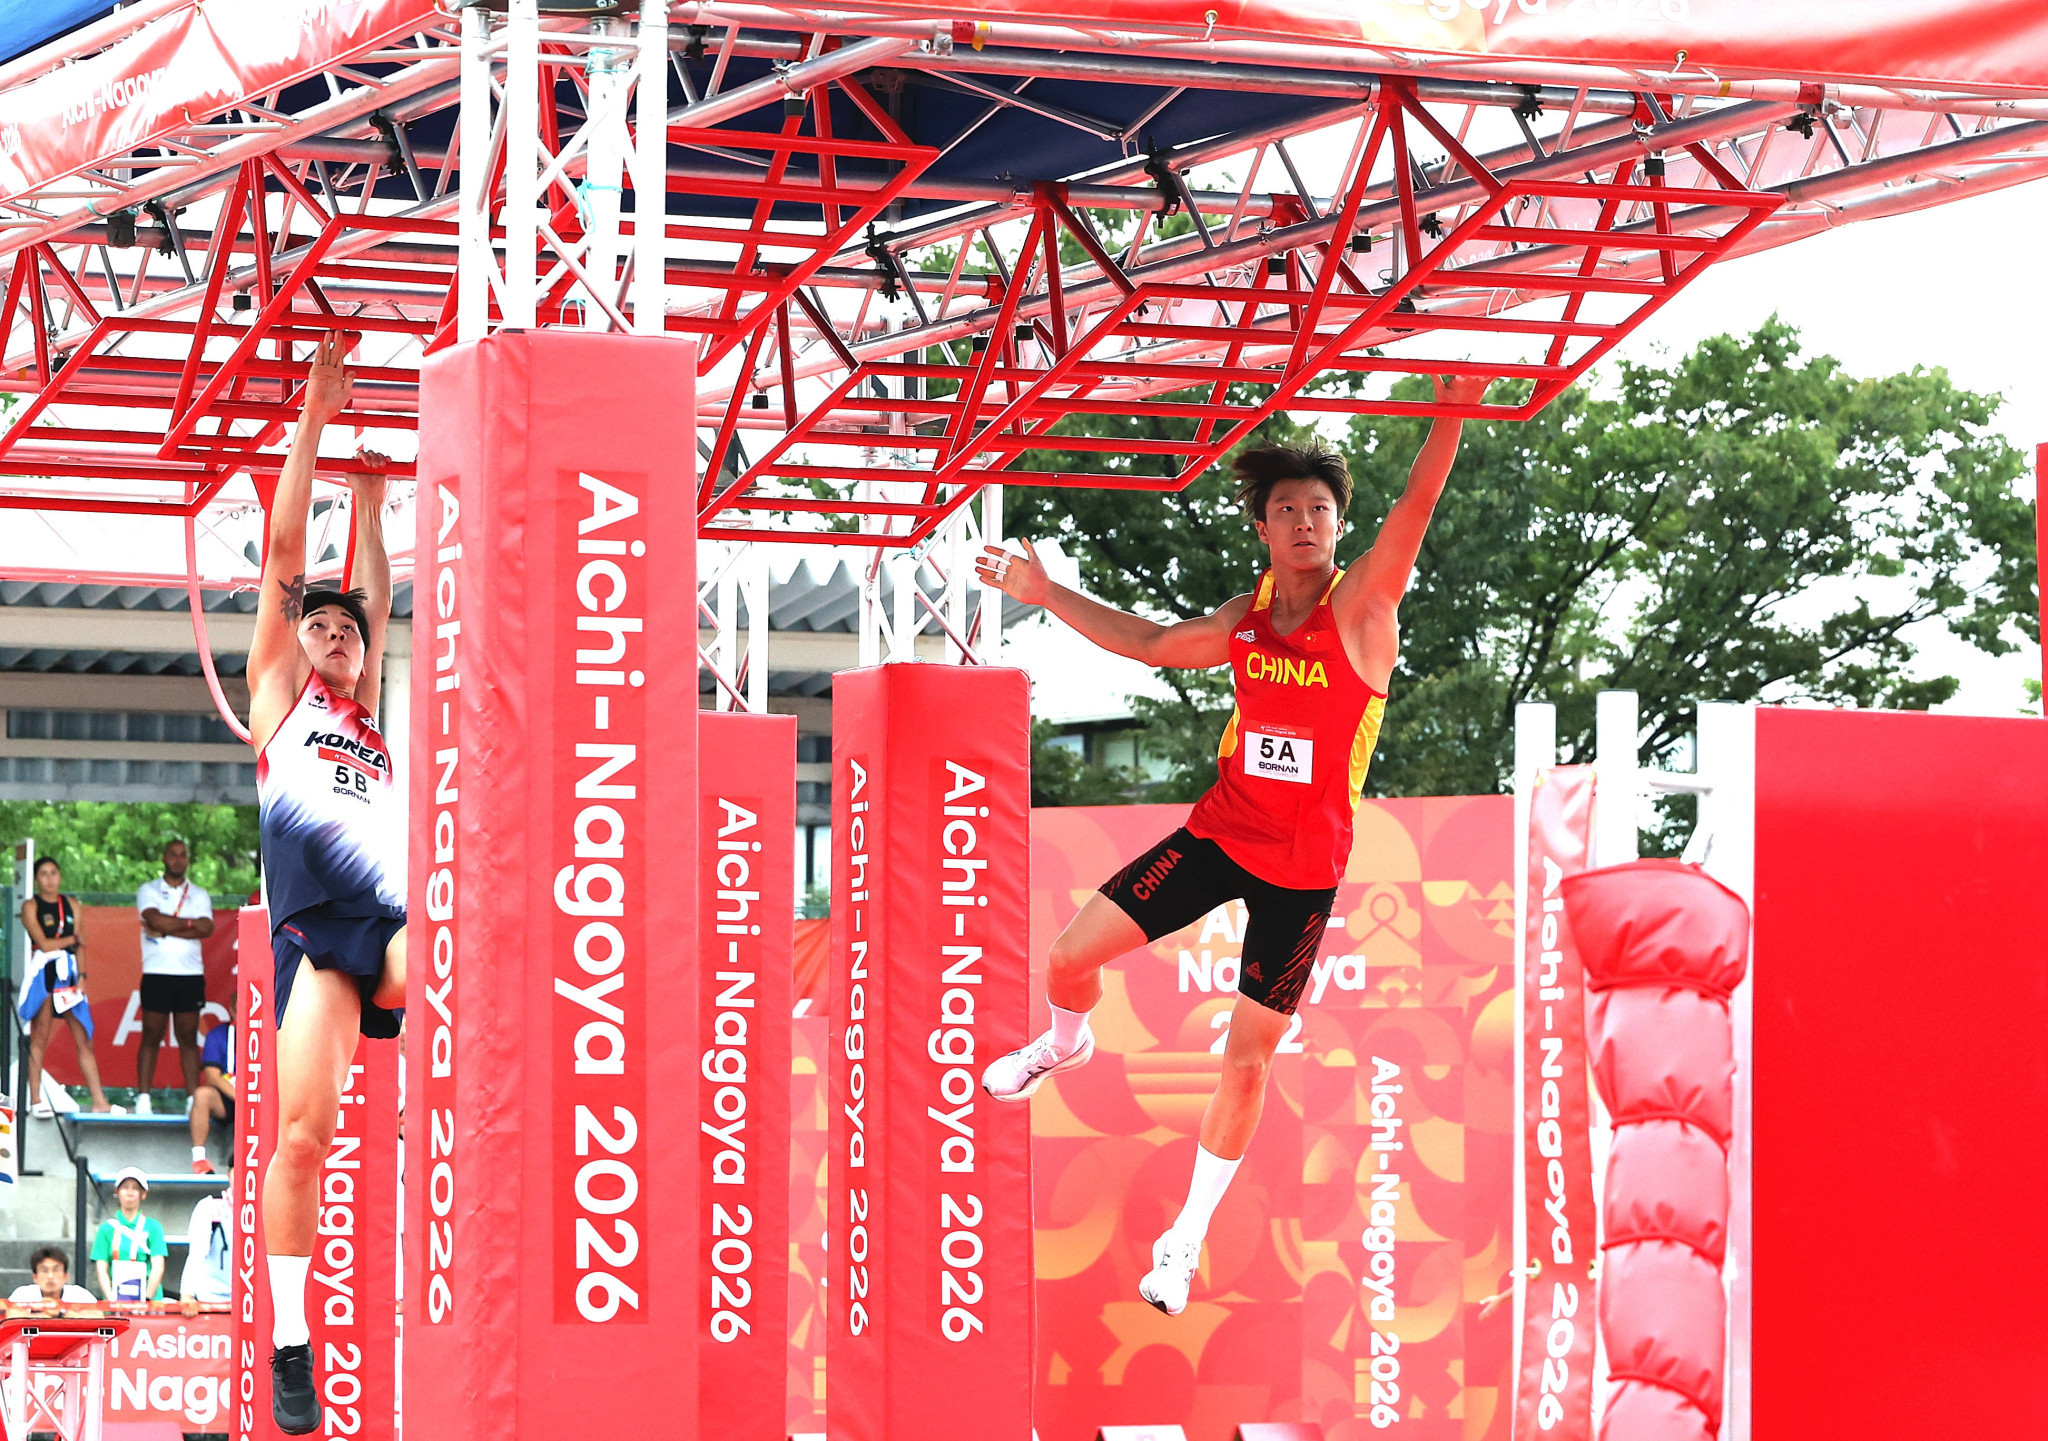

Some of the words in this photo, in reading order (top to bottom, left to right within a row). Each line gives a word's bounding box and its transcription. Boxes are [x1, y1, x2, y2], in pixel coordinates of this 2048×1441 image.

[1246, 652, 1329, 688] CHINA
[304, 731, 388, 773] KOREA
[333, 786, 371, 805] BORNAN
[426, 483, 462, 1078] Aichi-Nagoya
[553, 471, 646, 1075] Aichi-Nagoya
[1258, 761, 1299, 774] BORNAN
[1132, 848, 1183, 901] CHINA
[701, 797, 762, 1185] Aichi-Nagoya
[845, 758, 869, 1168] Aichi-Nagoya
[927, 759, 990, 1173] Aichi-Nagoya
[1178, 950, 1366, 1004] Naya
[1537, 855, 1573, 1264] Aichi-Nagoya
[239, 982, 263, 1324] Aichi-Nagoya
[428, 1108, 455, 1324] 2026
[574, 1105, 639, 1323] 2026
[1362, 1055, 1404, 1321] Aichi-Nagoya
[710, 1203, 753, 1343] 2026
[849, 1188, 869, 1336] 2026
[940, 1193, 984, 1342] 2026
[130, 1326, 232, 1359] Asian
[240, 1339, 255, 1441] 202
[324, 1342, 362, 1441] 202
[1370, 1331, 1400, 1429] 2026
[1537, 1282, 1579, 1431] 2026
